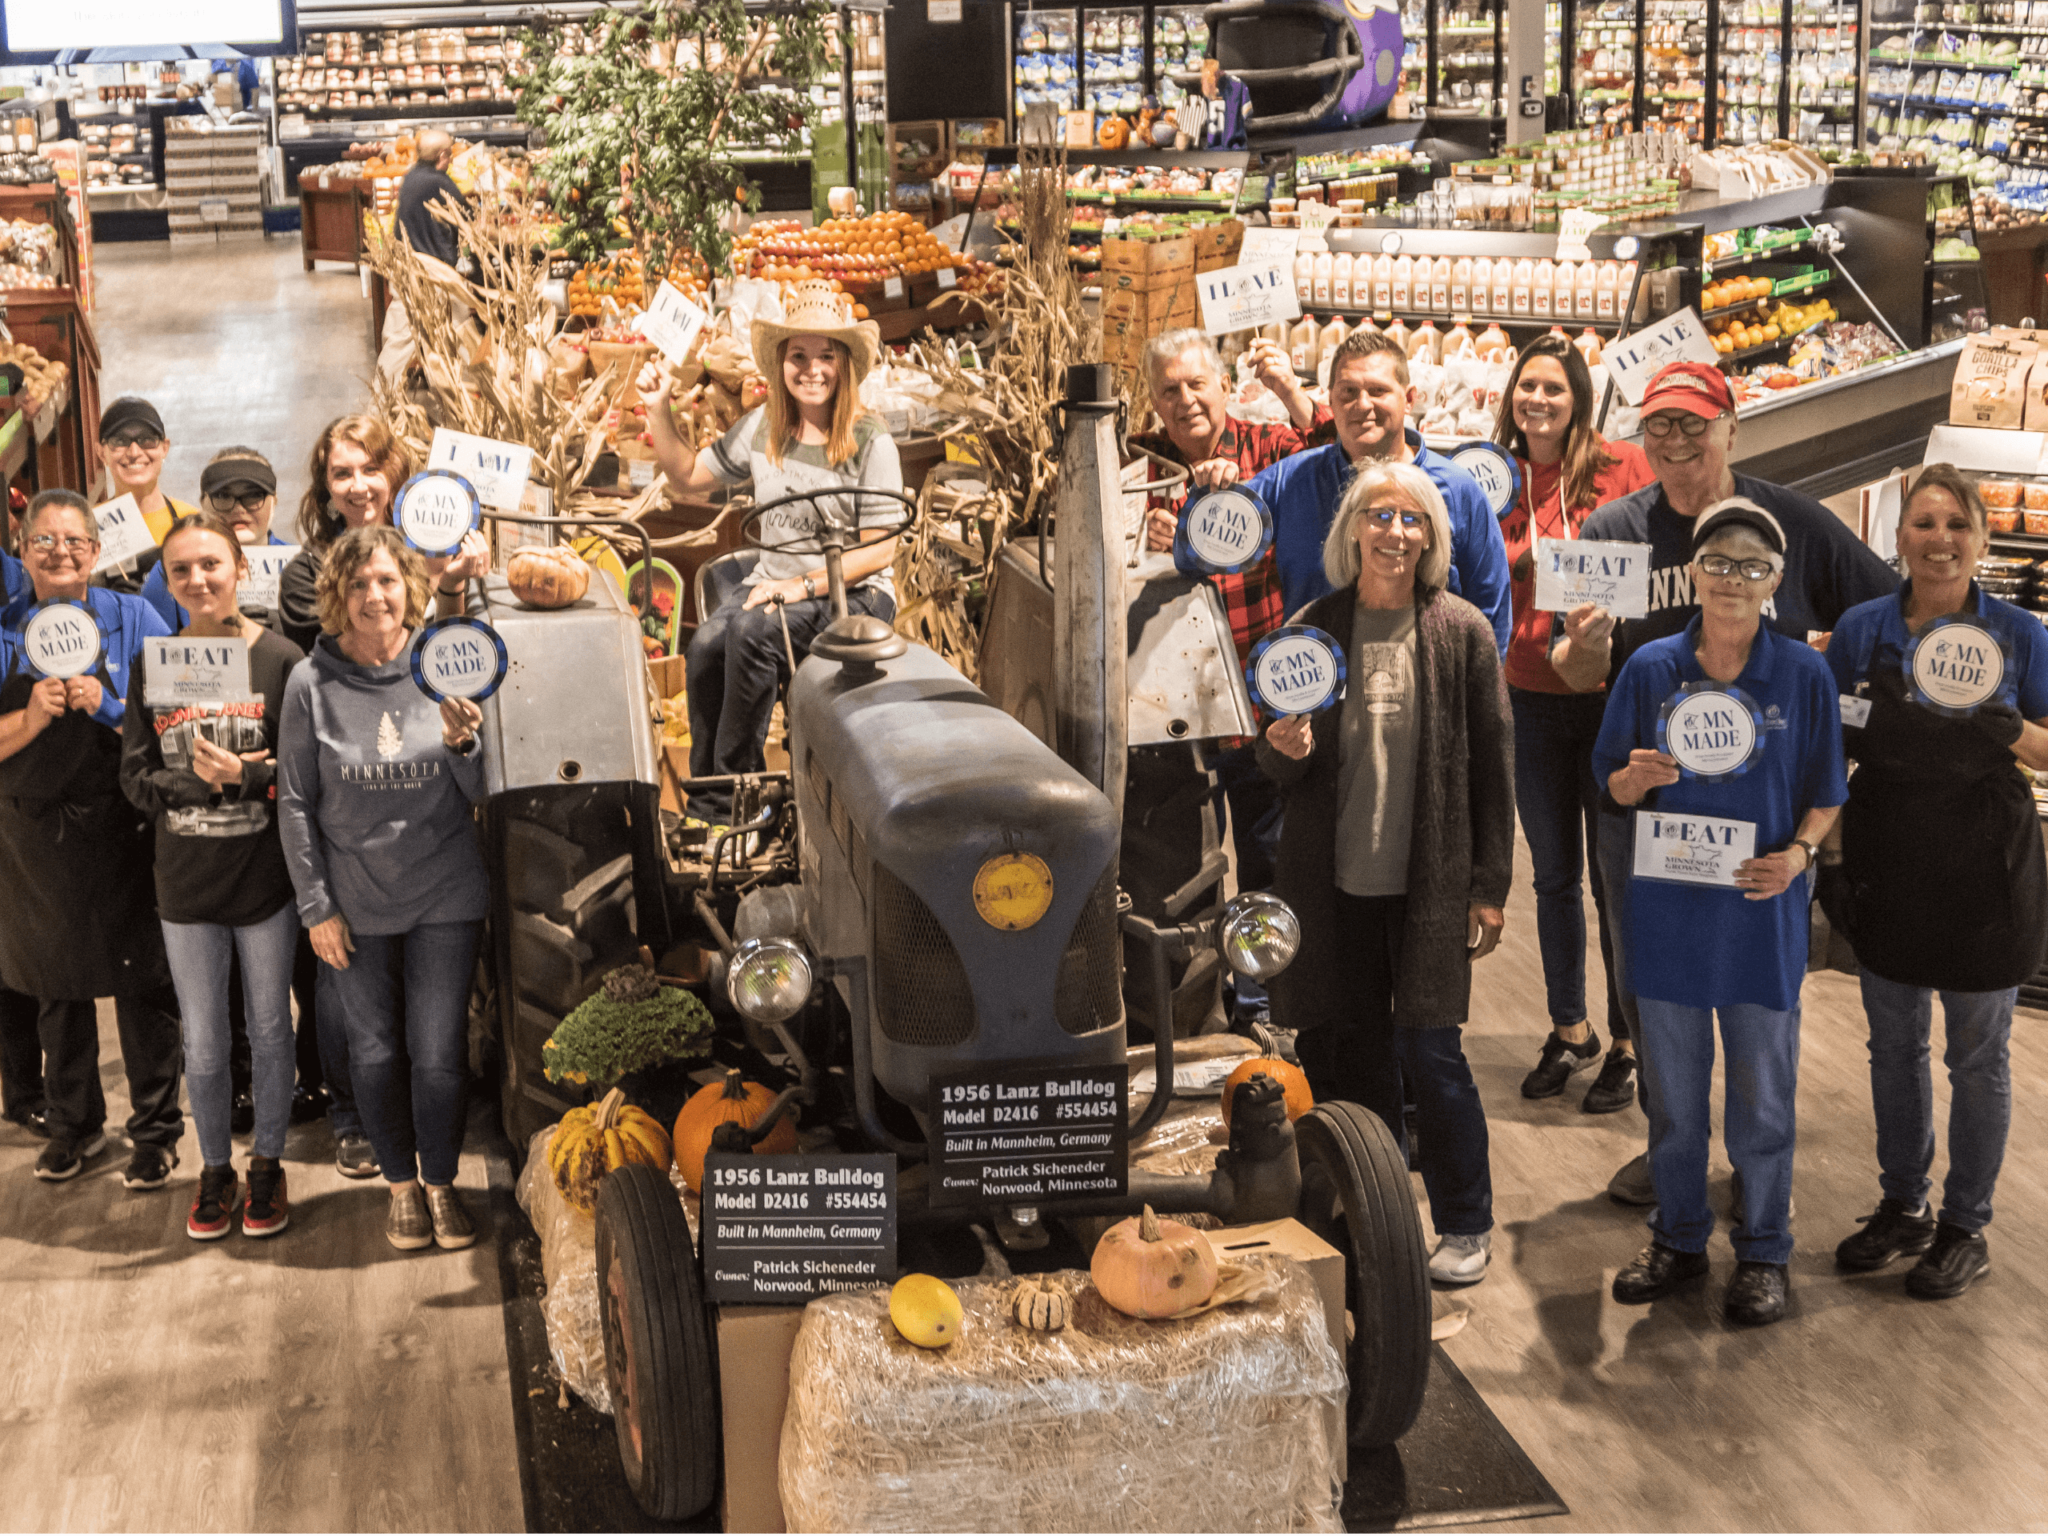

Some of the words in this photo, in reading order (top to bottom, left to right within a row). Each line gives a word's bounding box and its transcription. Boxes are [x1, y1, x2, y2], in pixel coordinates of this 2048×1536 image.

[1209, 284, 1216, 300] I
[1228, 304, 1272, 318] MINNESOTA
[1229, 313, 1258, 324] GROWN
[1616, 355, 1628, 371] I
[1972, 351, 2018, 369] GORILLA
[1976, 364, 2008, 377] CHIPS
[449, 445, 456, 461] I
[1480, 475, 1502, 493] DE
[432, 494, 457, 511] MN
[413, 509, 458, 529] MADE
[1223, 509, 1251, 532] MN
[1198, 517, 1248, 550] MADE
[1553, 553, 1560, 572] I
[1578, 554, 1632, 577] EAT
[1563, 590, 1615, 600] MINNESOTA
[54, 619, 81, 636] MN
[40, 636, 88, 658] MADE
[160, 647, 167, 665] I
[184, 647, 233, 665] EAT
[452, 640, 480, 658] MN
[1954, 643, 1988, 666] MN
[435, 656, 487, 678] MADE
[1286, 649, 1316, 672] MN
[1271, 665, 1326, 695] MADE
[1927, 658, 1987, 687] MADE
[1703, 709, 1734, 729] MN
[1682, 729, 1741, 751] MADE
[341, 761, 440, 781] MINNESOTA
[1653, 820, 1660, 838] I
[1681, 822, 1738, 845] EAT
[1665, 856, 1720, 868] MINNESOTA
[1665, 863, 1701, 872] GROWN
[942, 1085, 990, 1103] 1956
[996, 1084, 1040, 1100] Lanz
[1045, 1079, 1115, 1098] Bulldog
[943, 1108, 985, 1125] Model
[993, 1105, 1039, 1122] D2416
[1056, 1101, 1118, 1119] #554454
[945, 1138, 973, 1152] Built
[976, 1137, 987, 1150] in
[991, 1134, 1056, 1150] Mannheim,
[1060, 1133, 1112, 1146] Germany
[713, 1168, 761, 1186] 1956
[766, 1168, 809, 1186] Lanz
[814, 1168, 884, 1189] Bulldog
[982, 1164, 1029, 1178] Patrick
[1032, 1161, 1106, 1176] Sicheneder
[942, 1176, 979, 1188] Owner:
[982, 1180, 1044, 1195] Norwood,
[1048, 1177, 1117, 1192] Minnesota
[715, 1193, 756, 1209] Model
[763, 1193, 809, 1209] D2416
[825, 1192, 887, 1209] #554454
[718, 1224, 745, 1238] Built
[747, 1224, 759, 1238] in
[762, 1225, 826, 1240] Mannheim,
[830, 1224, 882, 1240] Germany
[715, 1270, 750, 1281] Owner:
[754, 1261, 799, 1274] Patrick
[803, 1261, 876, 1274] Sicheneder
[754, 1279, 814, 1293] Norwood,
